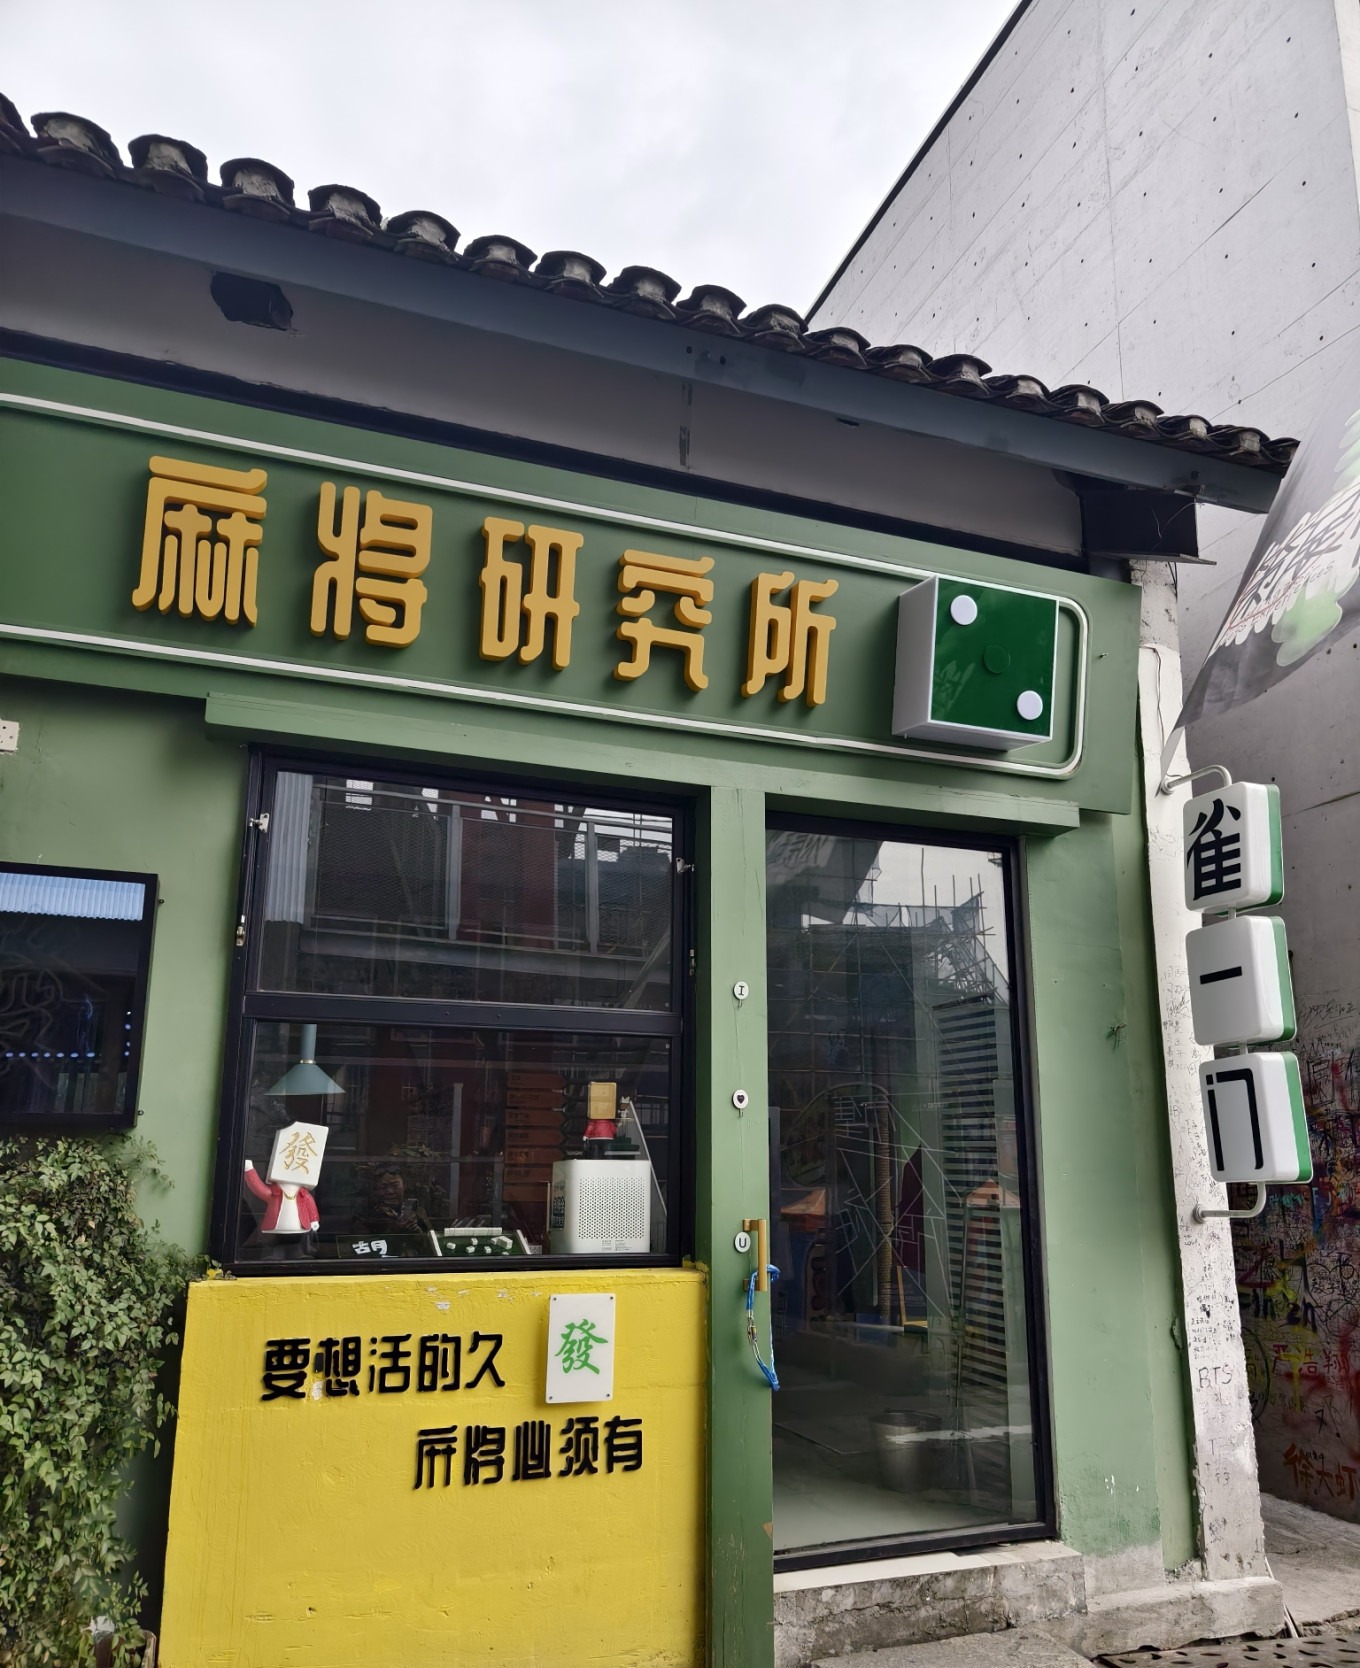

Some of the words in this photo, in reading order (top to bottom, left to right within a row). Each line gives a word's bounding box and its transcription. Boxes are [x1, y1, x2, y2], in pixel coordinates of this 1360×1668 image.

[131, 454, 840, 709] 麻将研究所
[259, 1330, 506, 1402] 要想活的久
[553, 1318, 609, 1376] 發
[1198, 1362, 1233, 1389] BTS
[413, 1415, 644, 1490] 麻将必须有
